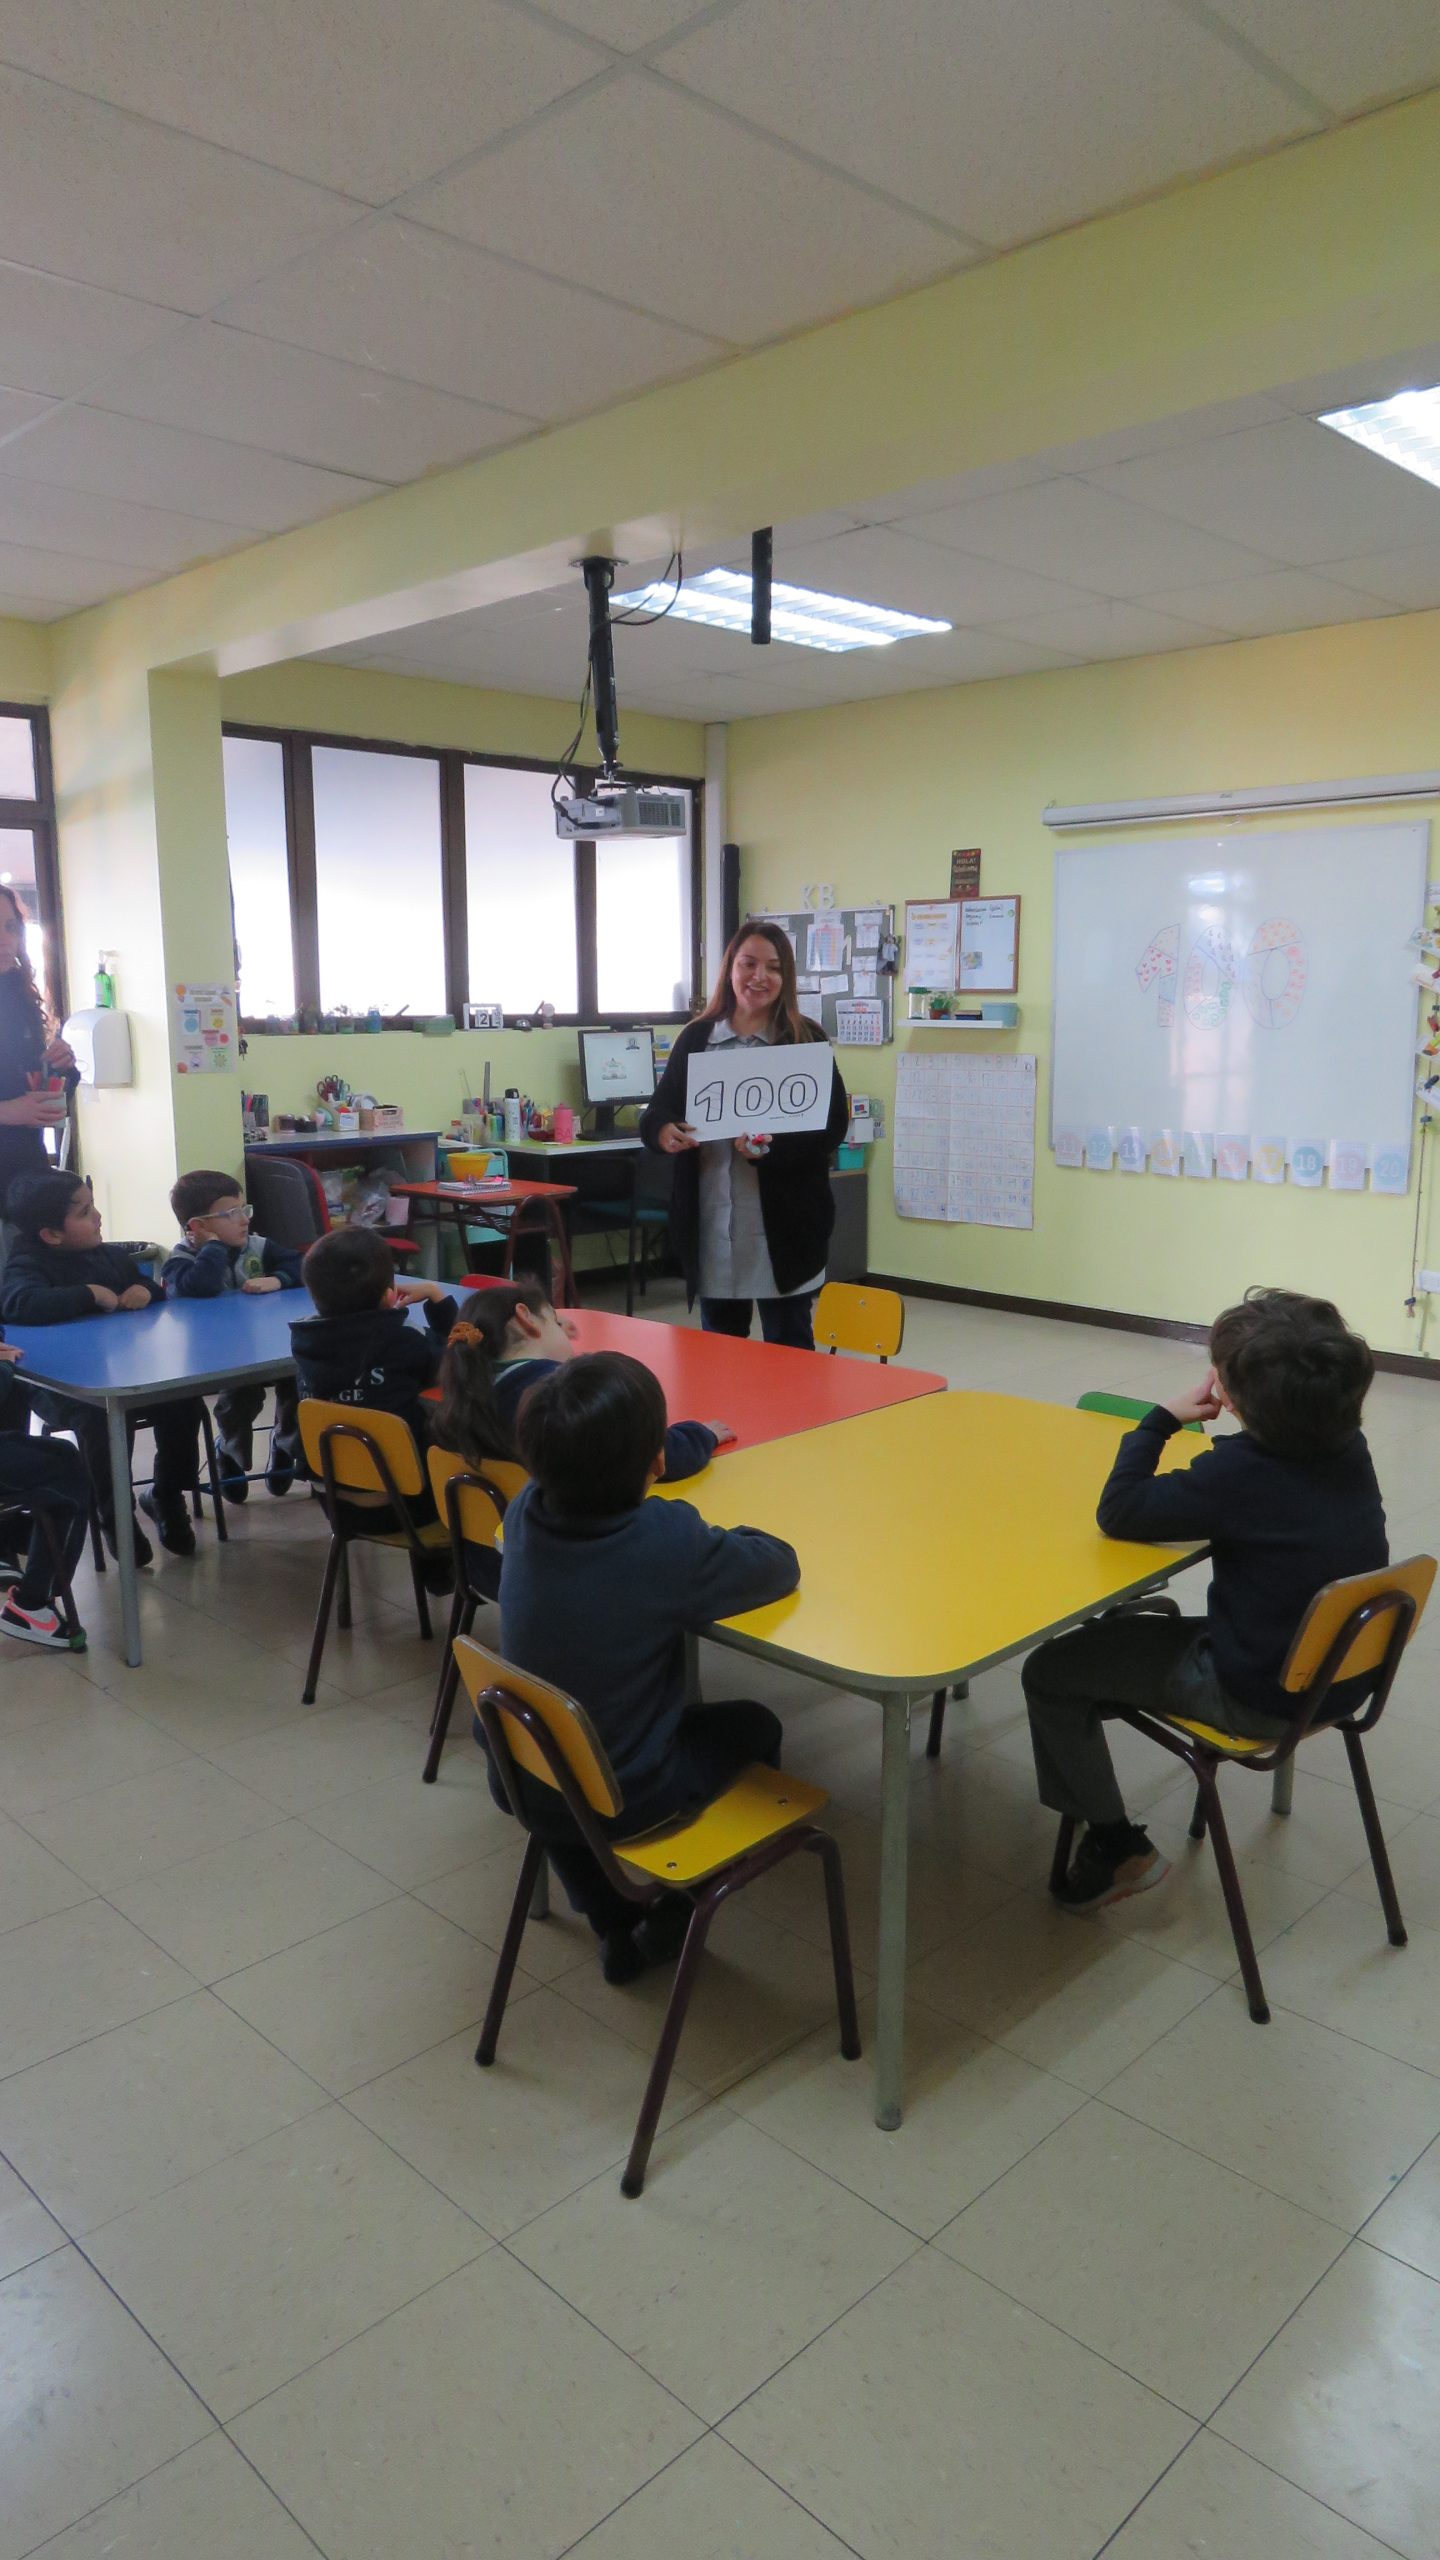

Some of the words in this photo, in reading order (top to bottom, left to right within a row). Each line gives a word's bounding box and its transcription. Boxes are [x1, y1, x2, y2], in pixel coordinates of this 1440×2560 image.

[802, 884, 835, 910] KB
[1135, 918, 1309, 1031] 100
[480, 1013, 488, 1025] 2
[694, 1073, 818, 1122] 100
[1091, 1141, 1107, 1157] 12
[1296, 1154, 1316, 1171] 18
[1338, 1158, 1358, 1174] 19
[1380, 1160, 1400, 1178] 20
